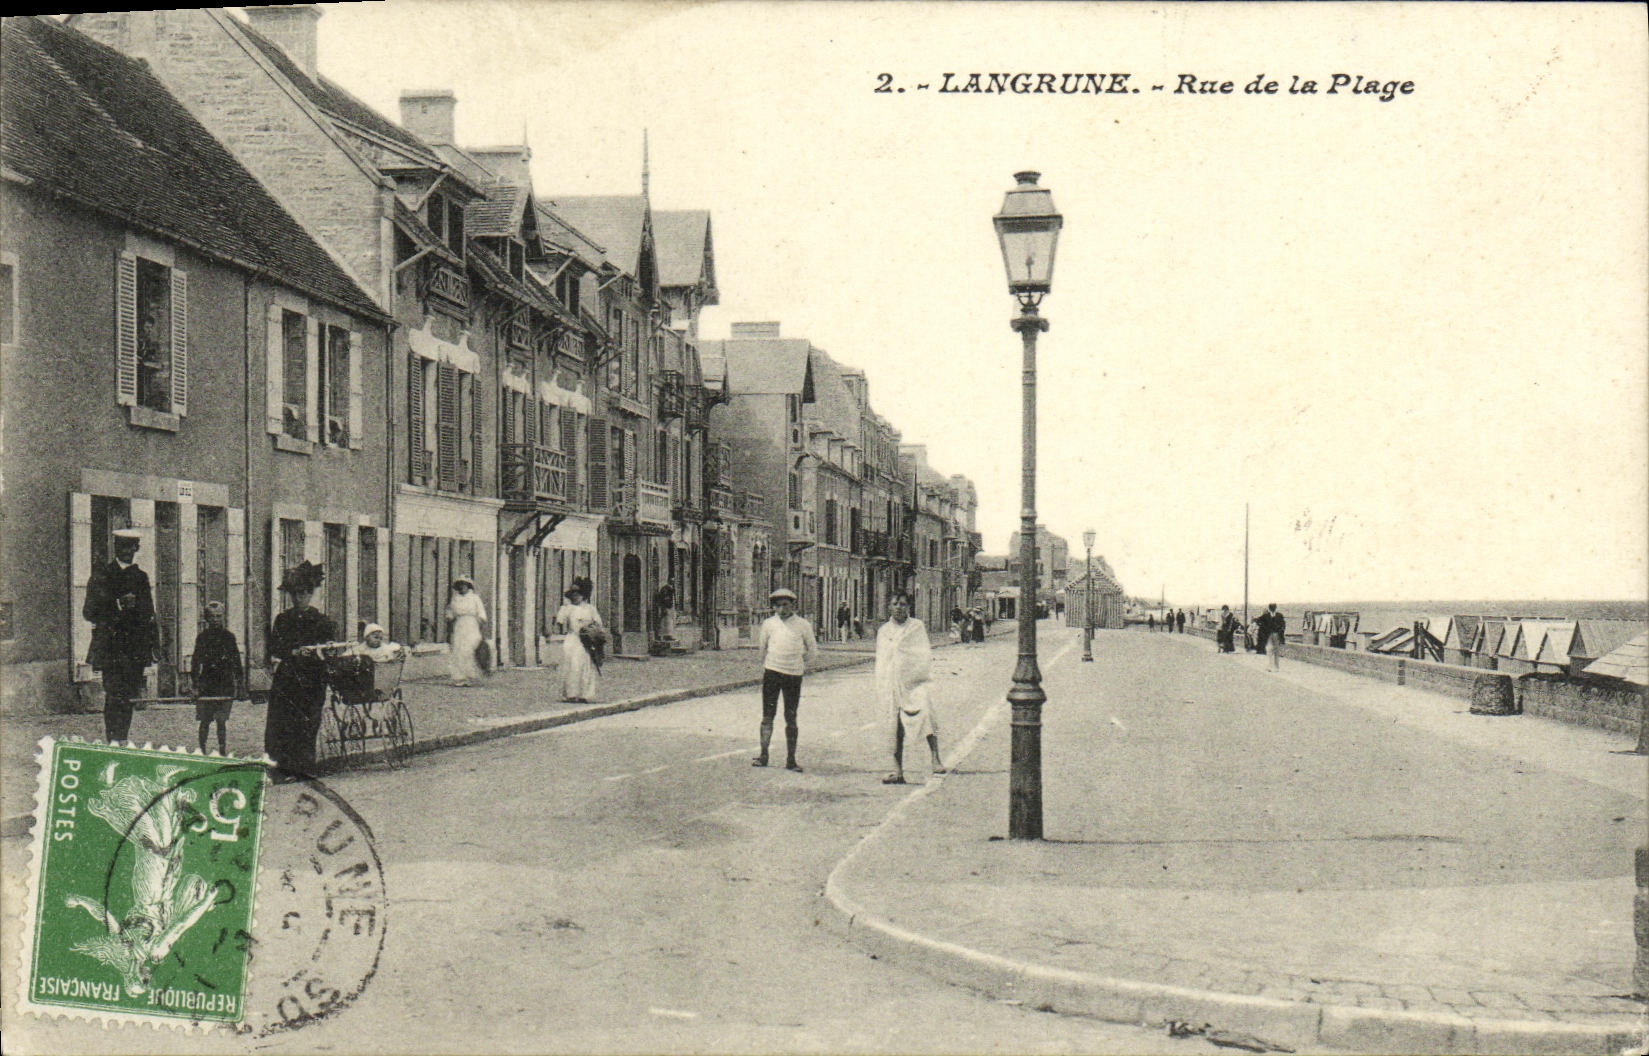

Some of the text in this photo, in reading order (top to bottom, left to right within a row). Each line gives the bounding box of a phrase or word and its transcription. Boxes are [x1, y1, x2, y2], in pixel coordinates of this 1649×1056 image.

[54, 759, 82, 842] POSTES
[39, 976, 237, 1014] REPUBLIQUE FRANÇAISE
